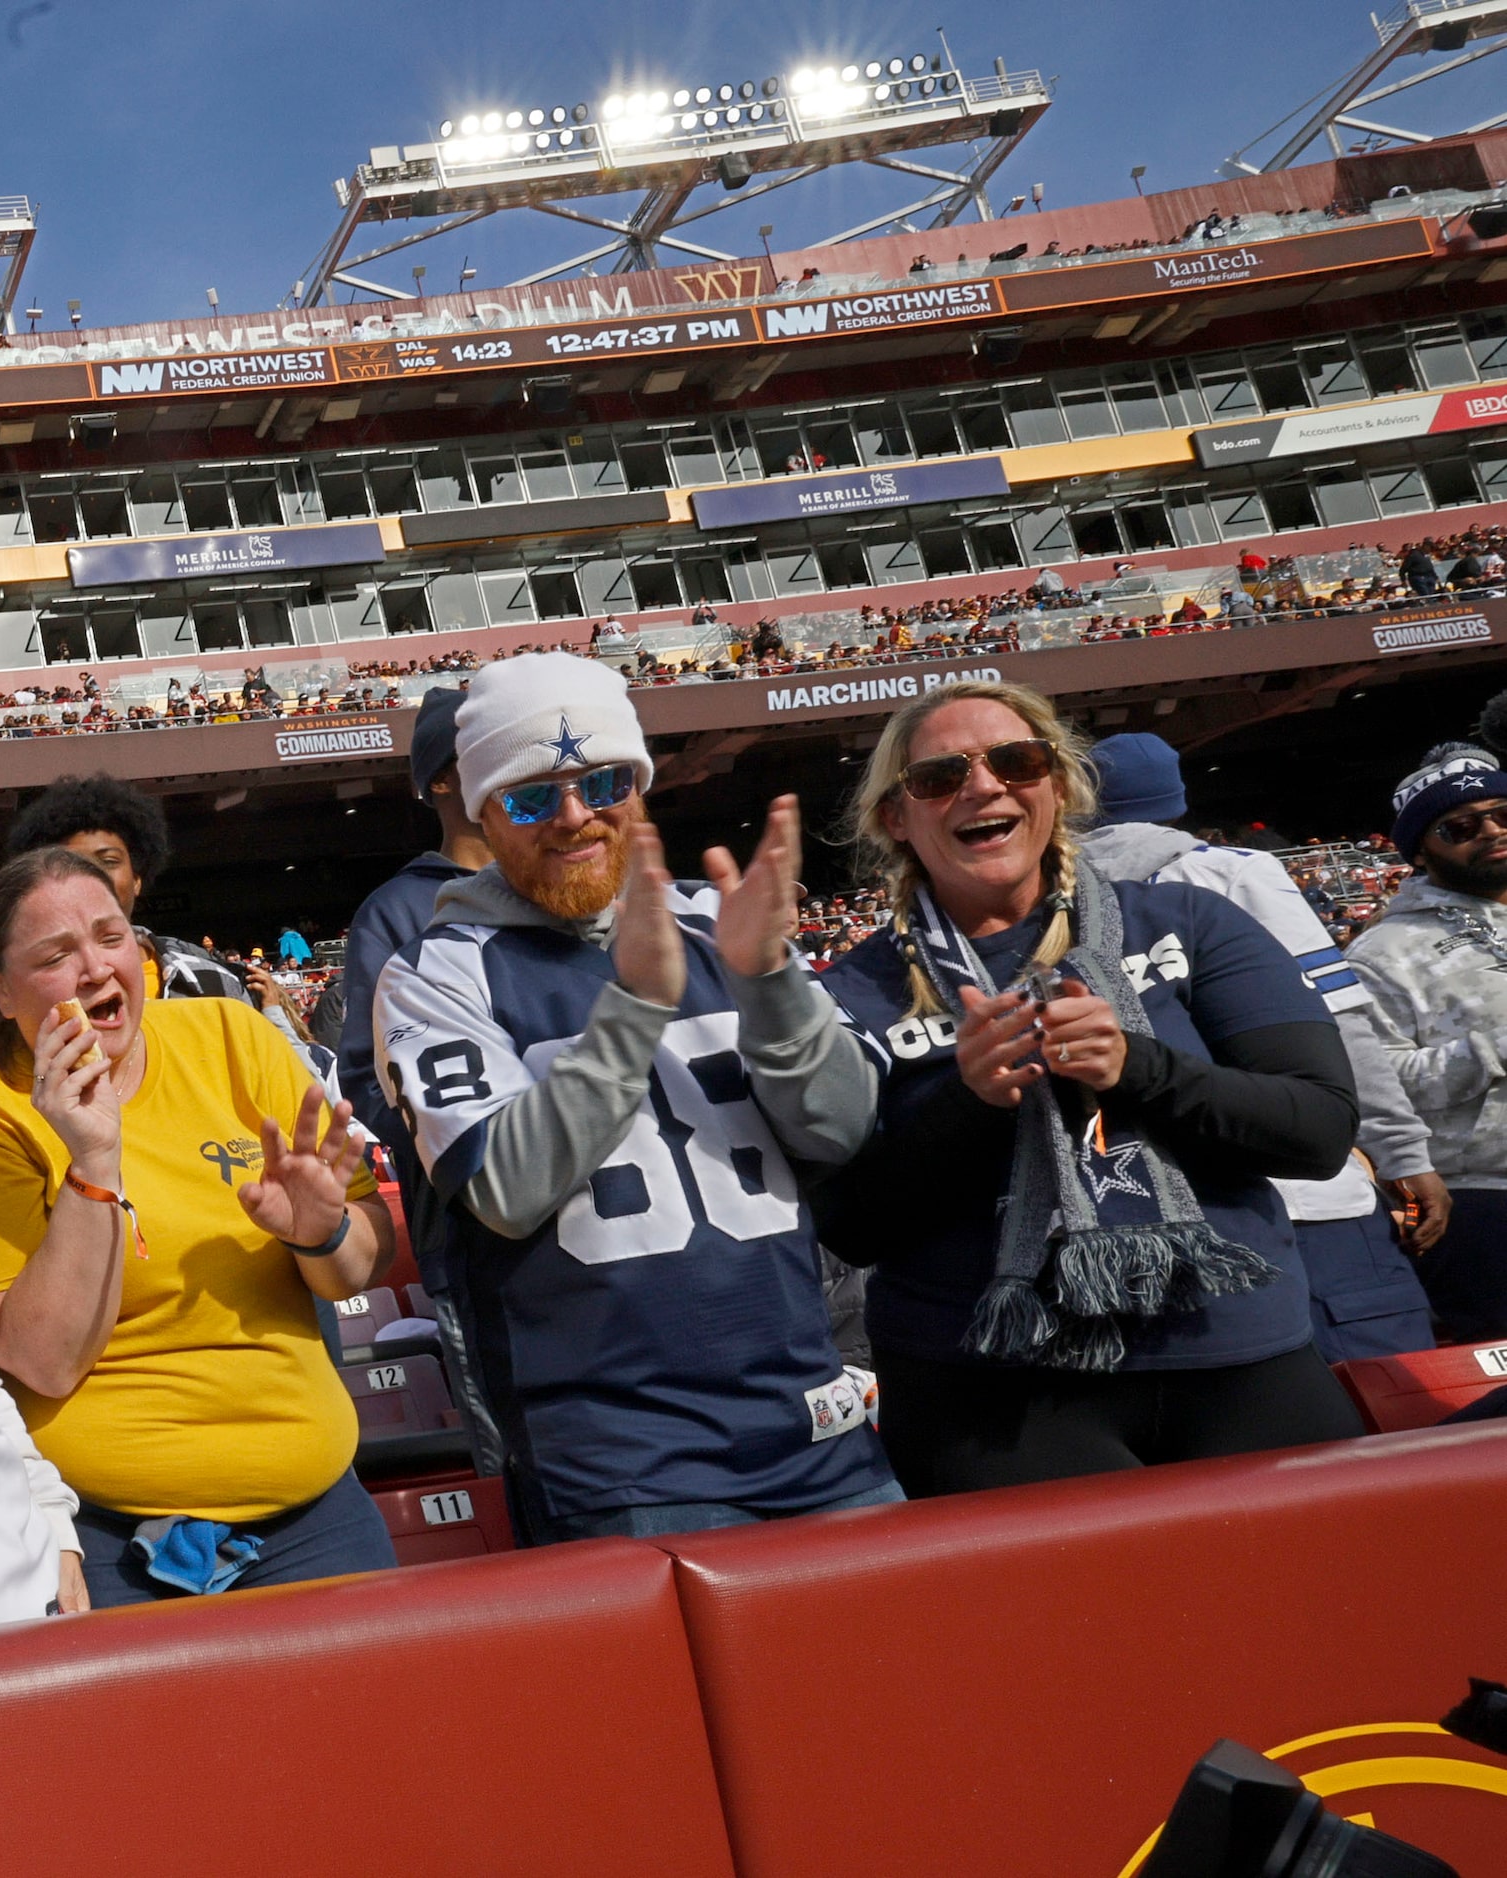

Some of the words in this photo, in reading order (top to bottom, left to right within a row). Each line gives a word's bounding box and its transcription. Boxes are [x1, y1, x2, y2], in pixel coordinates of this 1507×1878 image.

[1153, 249, 1259, 279] ManTech
[1169, 276, 1206, 288] Securing
[1207, 273, 1221, 282] the
[1222, 270, 1250, 280] Future
[766, 303, 828, 338] NW
[831, 283, 990, 318] NORTHWEST
[837, 314, 894, 330] FEDERAL
[897, 308, 943, 323] CREDIT
[947, 302, 991, 317] UNION
[546, 325, 678, 354] 12:47:37
[687, 319, 740, 341] PM
[395, 340, 428, 353] DAL
[451, 340, 513, 362] 14:23
[399, 355, 436, 368] WAS
[101, 361, 165, 395] NW
[168, 351, 326, 379] NORTHWEST
[172, 377, 226, 390] FEDERAL
[232, 374, 278, 387] CREDIT
[282, 369, 326, 383] UNION
[1298, 421, 1363, 439] Accountants
[1365, 417, 1374, 429] &
[1376, 412, 1420, 427] Advisors
[1212, 436, 1261, 451] bdo.com
[798, 486, 871, 505] MERRILL
[808, 504, 829, 512] BANK
[829, 502, 839, 510] OF
[840, 499, 873, 509] AMERICA
[874, 494, 910, 505] COMPANY
[175, 549, 248, 566] MERRILL
[183, 565, 205, 573] BANK
[216, 561, 249, 570] AMERICA
[250, 559, 286, 568] COMPANY
[1380, 607, 1474, 624] WASHINGTON
[1373, 618, 1491, 648] COMMANDERS
[767, 676, 918, 711] MARCHING
[283, 716, 379, 731] WASHINGTON
[276, 729, 393, 756] COMMANDERS
[345, 1297, 364, 1313] 13
[375, 1367, 399, 1388] 12
[432, 1494, 463, 1522] 11
